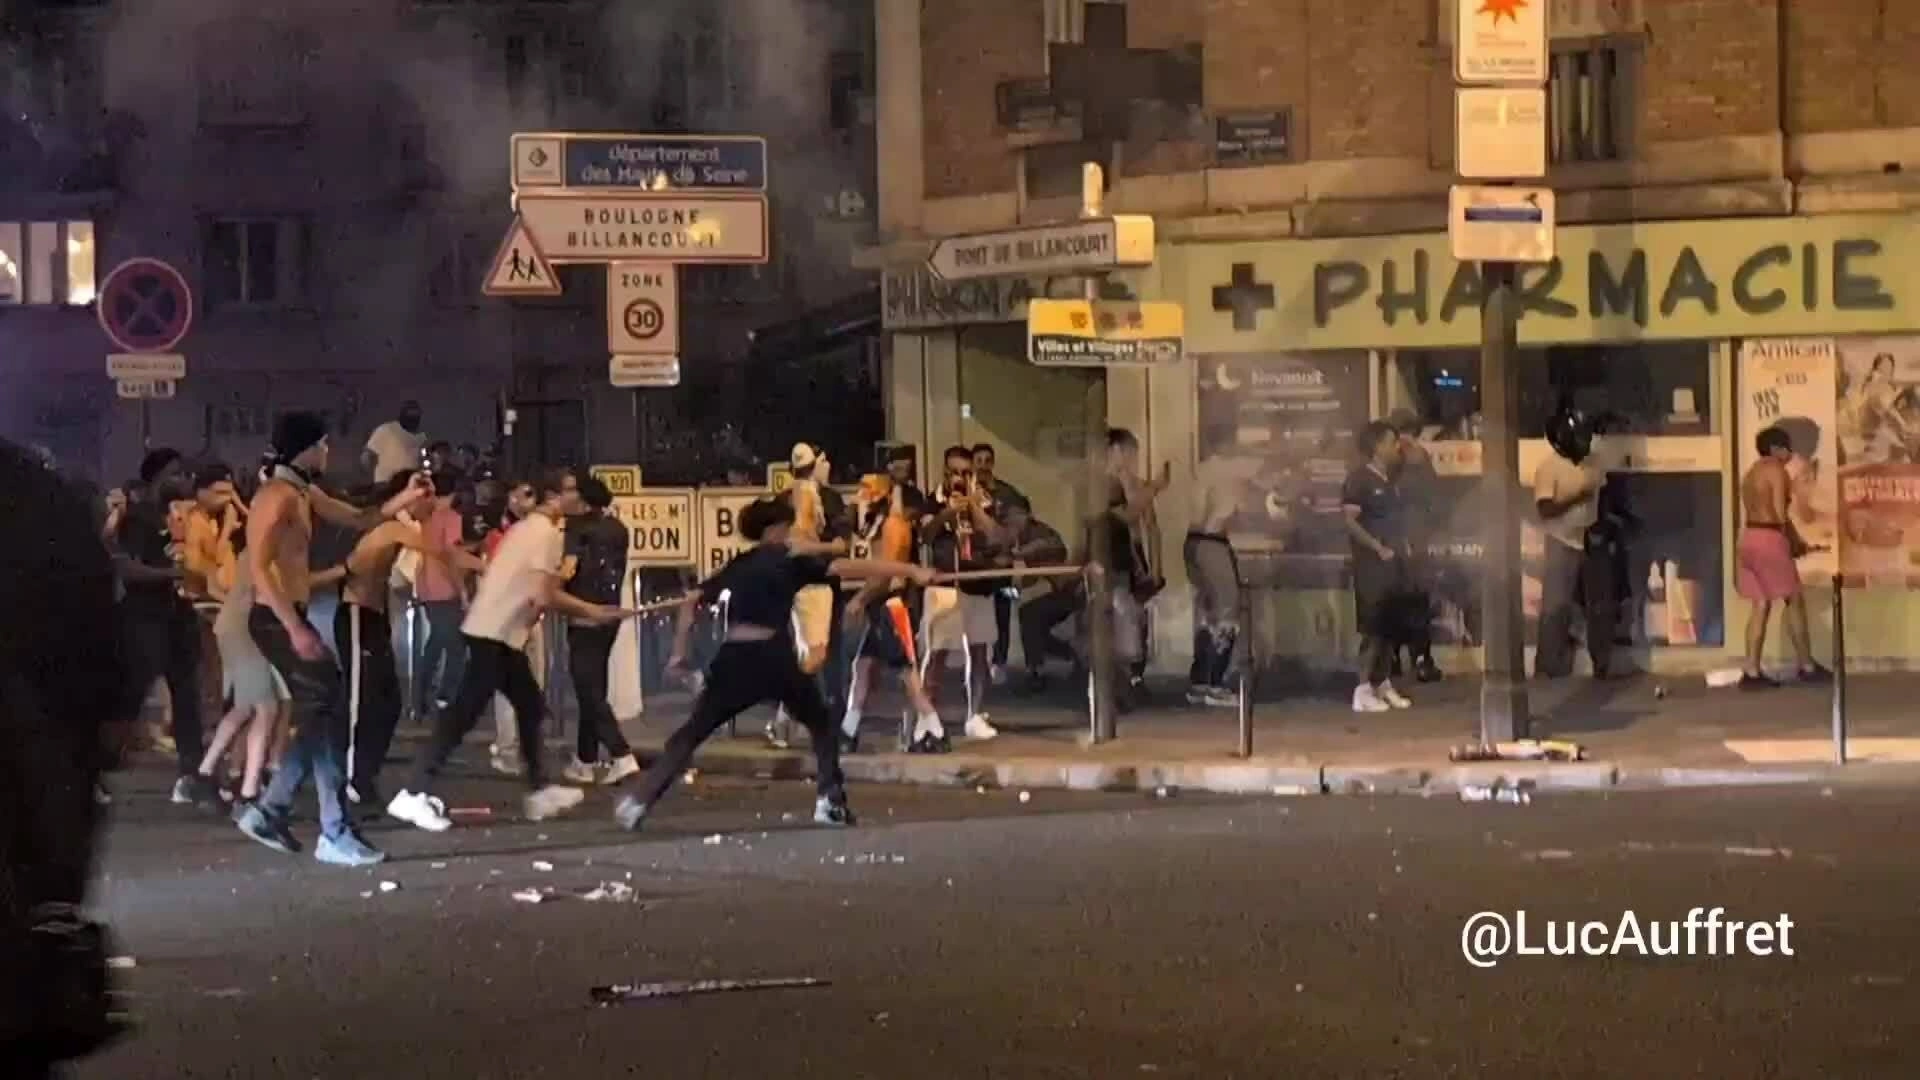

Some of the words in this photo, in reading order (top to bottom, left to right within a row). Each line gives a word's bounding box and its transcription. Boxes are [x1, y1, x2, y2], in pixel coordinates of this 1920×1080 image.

[584, 208, 701, 225] BOULOGNE
[1016, 233, 1108, 260] BILLANCOURT
[621, 273, 663, 288] ZONE
[1313, 238, 1895, 328] PHARMACIE
[631, 310, 656, 328] 30
[632, 527, 680, 550] DON
